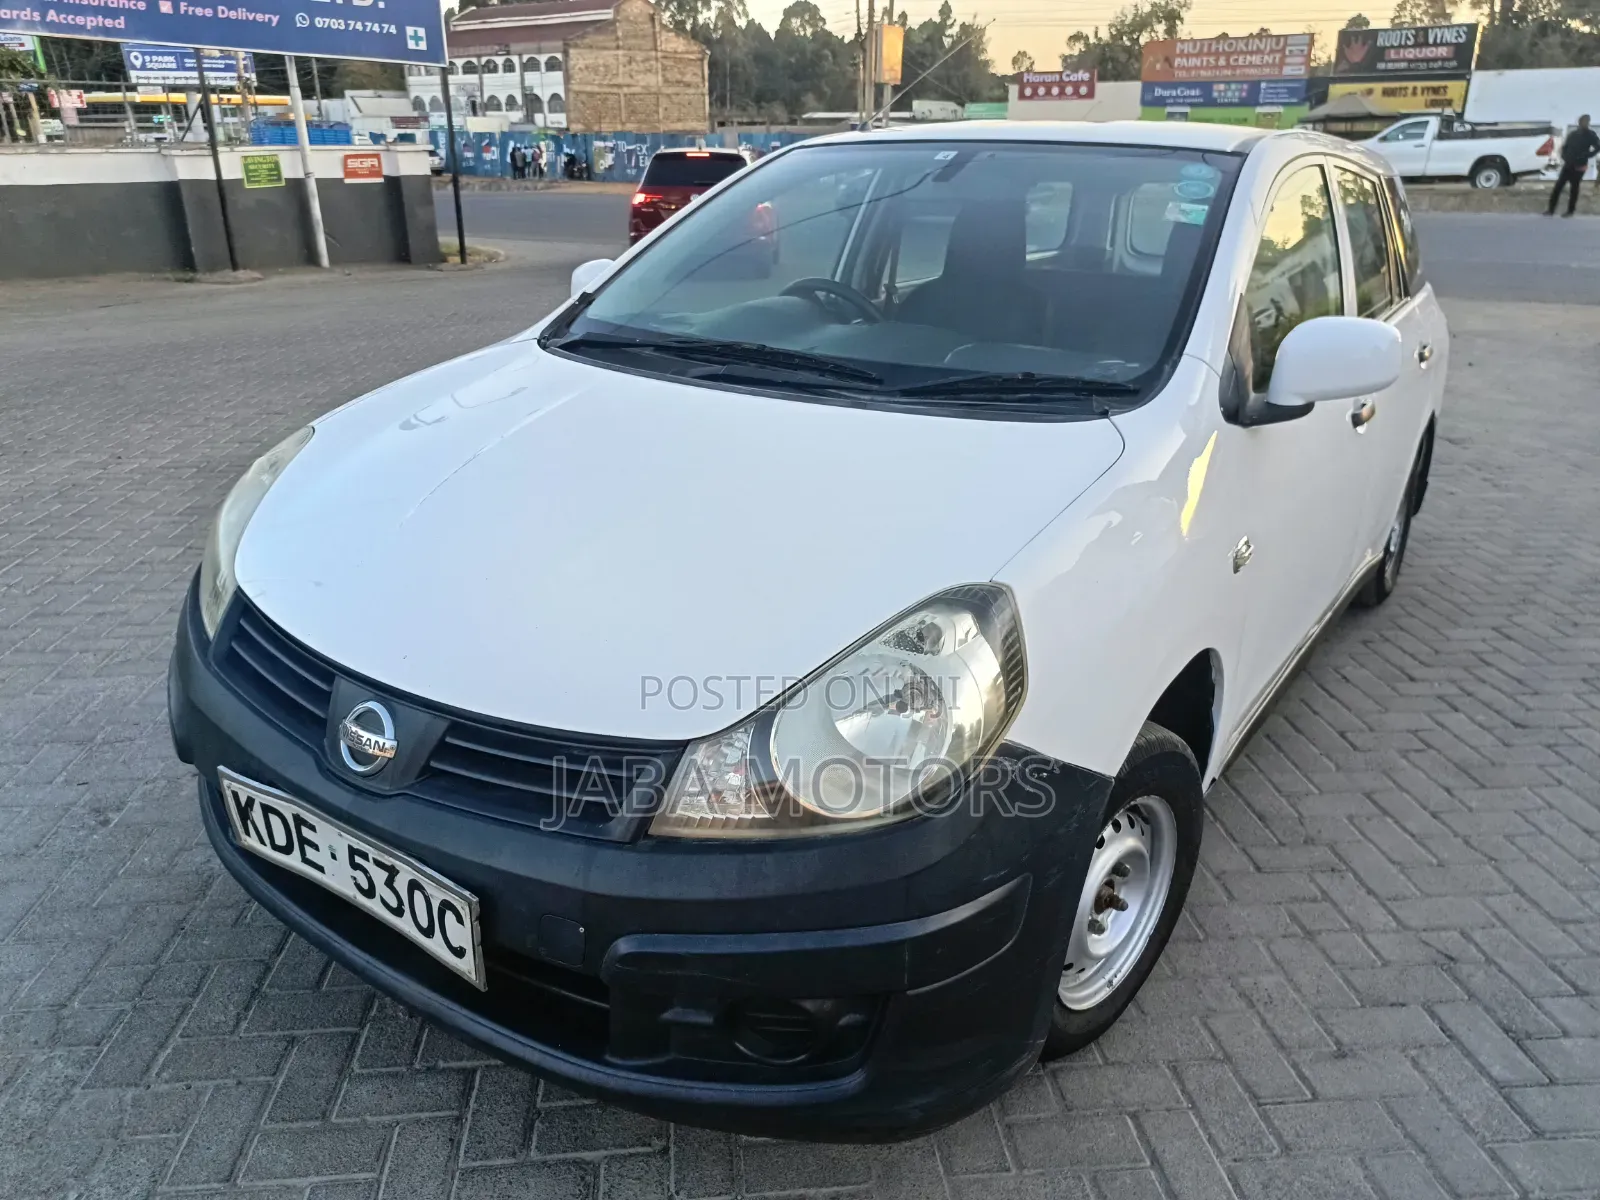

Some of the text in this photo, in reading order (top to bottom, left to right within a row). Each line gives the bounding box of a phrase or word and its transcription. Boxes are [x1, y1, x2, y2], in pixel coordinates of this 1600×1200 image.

[0, 8, 125, 30] ards Accepted
[180, 5, 280, 27] Free Delivery
[314, 17, 397, 35] 0703 74 74 74
[1175, 36, 1285, 55] MUTHOKINJU
[1376, 29, 1416, 47] ROOTS
[1428, 26, 1468, 45] VYNES
[152, 55, 176, 63] PARK
[1174, 54, 1282, 68] PAINTS & CEMENT
[1389, 47, 1449, 59] LIQUOR
[1062, 69, 1091, 82] Cafe
[1381, 86, 1410, 97] ROOTS
[1421, 85, 1449, 97] VYNES
[347, 157, 379, 169] SGA
[341, 724, 387, 753] NISSAN
[230, 789, 467, 960] KDE 530C
